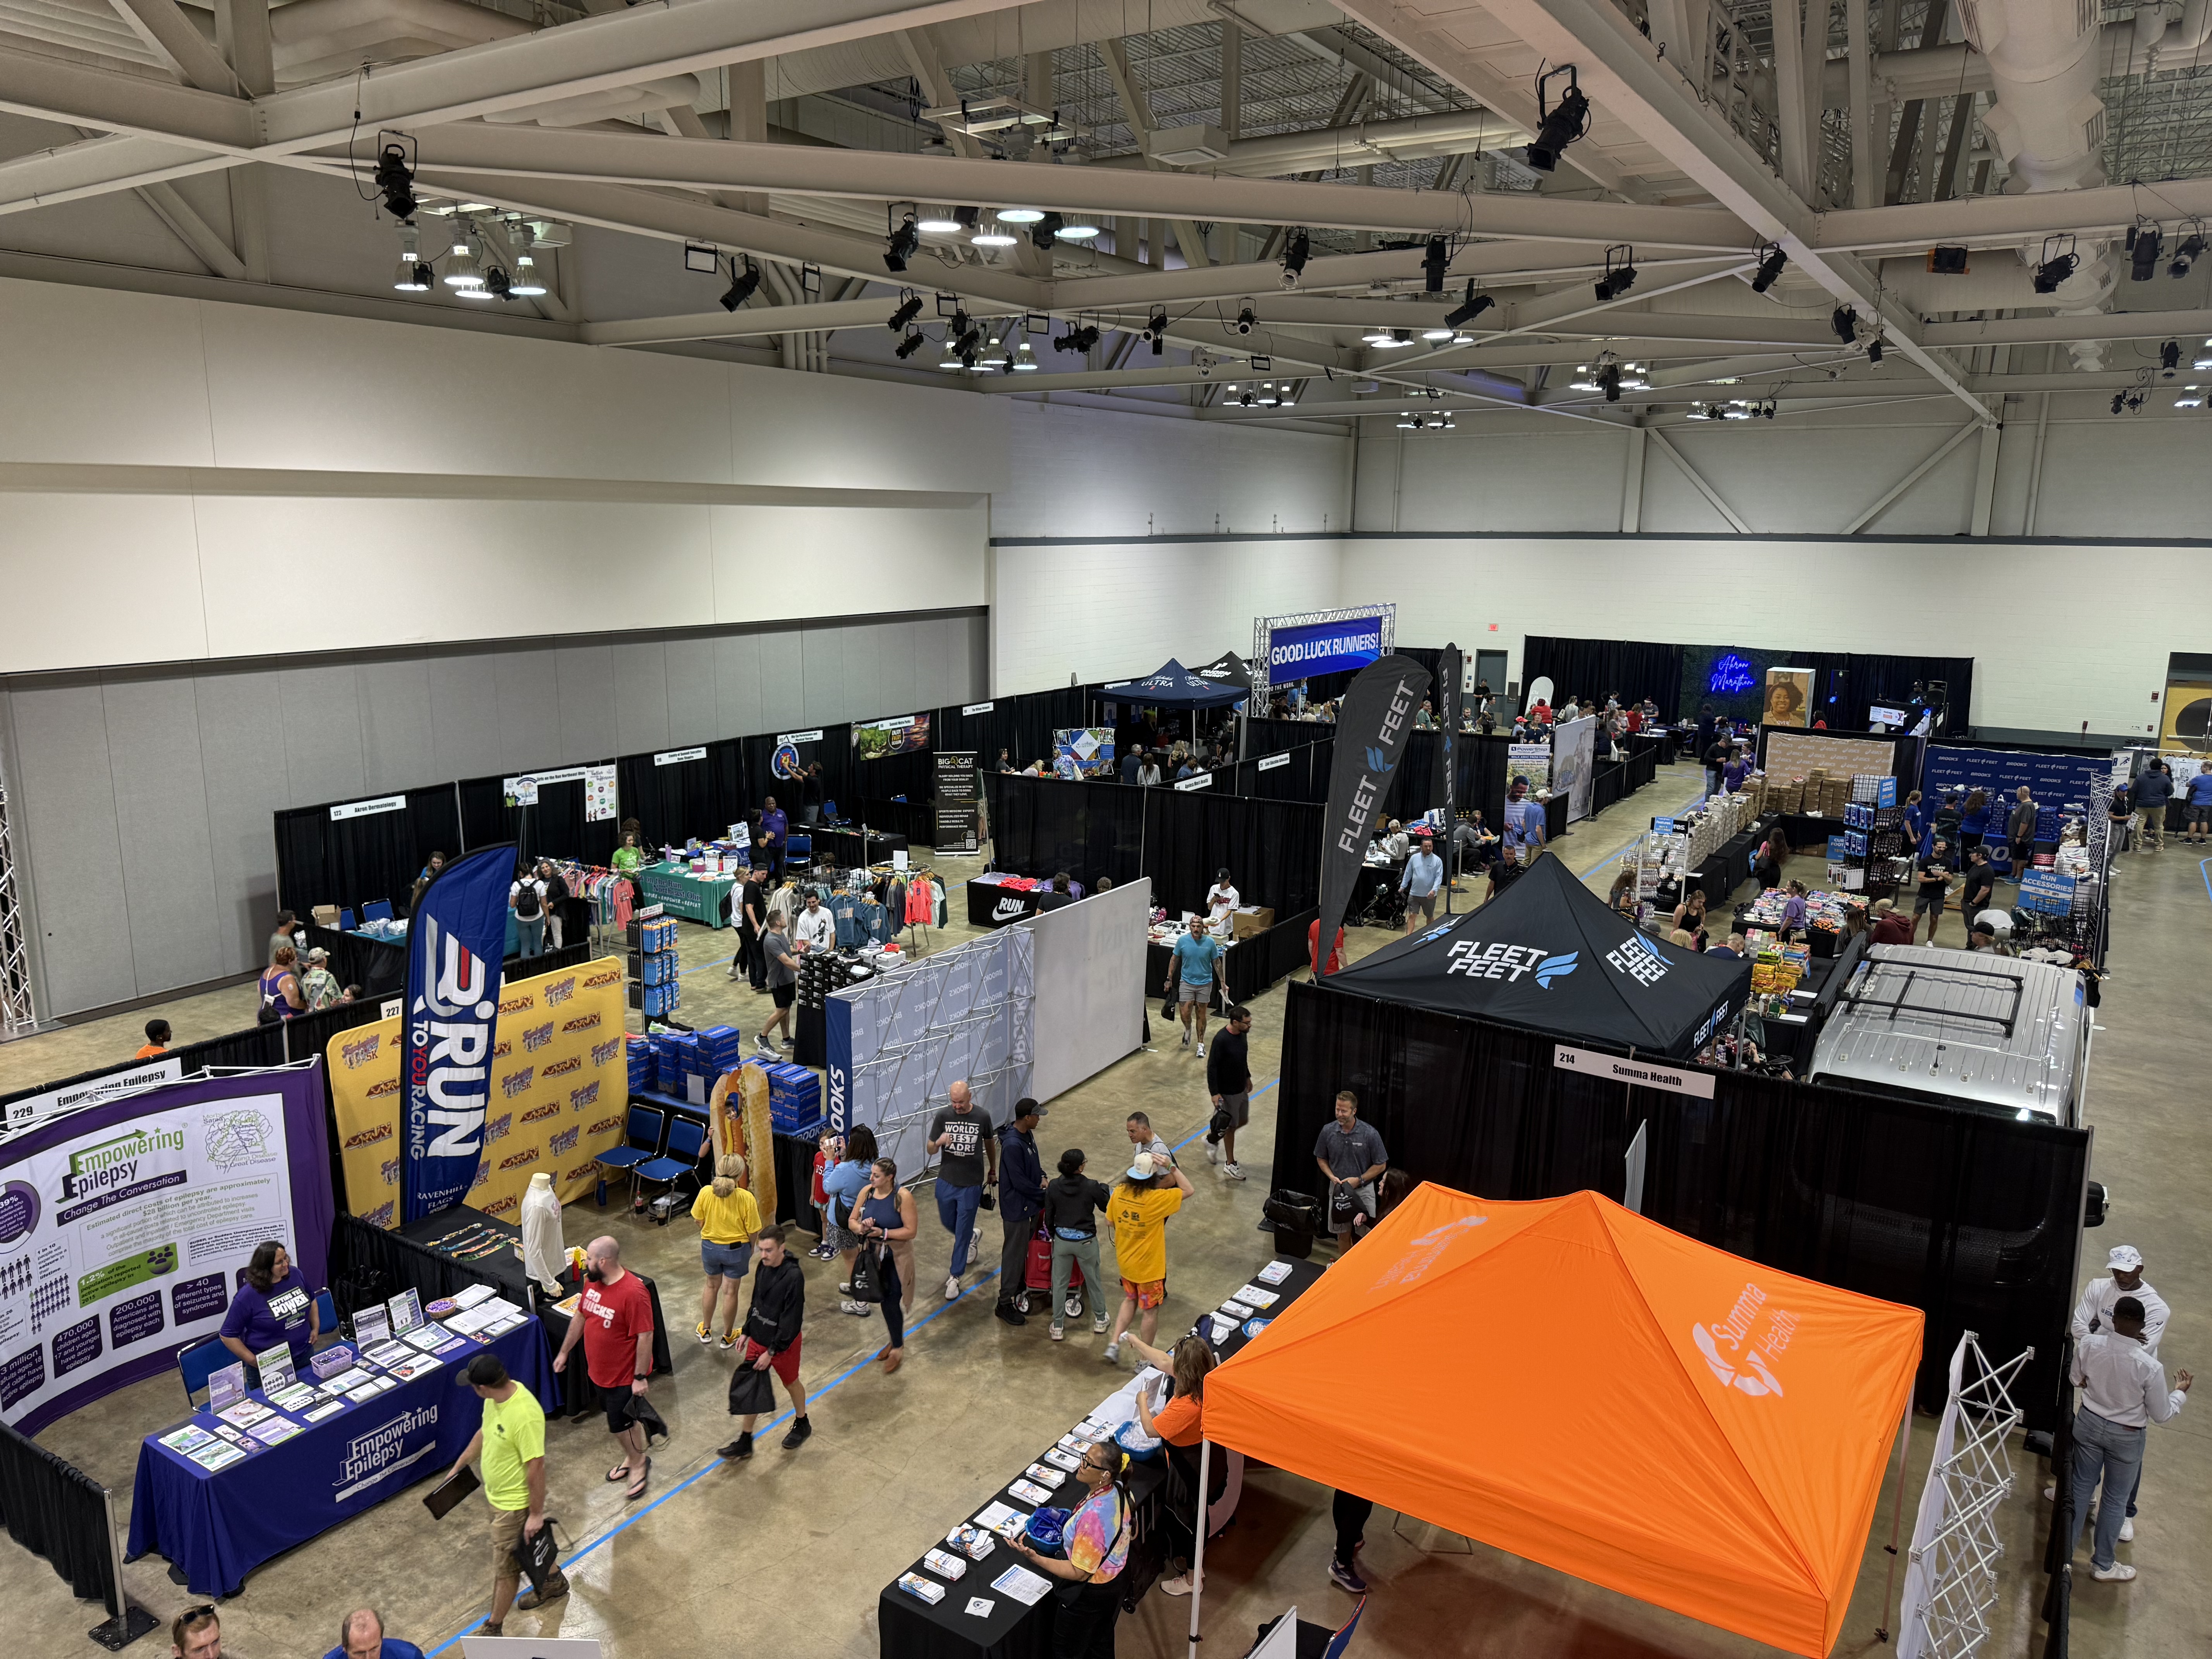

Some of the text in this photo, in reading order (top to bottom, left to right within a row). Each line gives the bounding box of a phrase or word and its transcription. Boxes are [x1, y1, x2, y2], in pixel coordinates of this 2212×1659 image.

[1271, 632, 1379, 665] GOOD LUCK RUNNERS!
[1338, 680, 1413, 853] FLEET FEET
[368, 802, 396, 811] Dermatology
[668, 879, 682, 889] Run
[2022, 878, 2072, 893] ACCESSORIES
[2040, 874, 2056, 882] RUN
[653, 884, 702, 901] Northeast Ohio
[999, 897, 1025, 912] RUN
[1447, 940, 1548, 967] FLEET
[1605, 936, 1650, 974] FLEET
[1446, 958, 1532, 982] FEET
[1629, 955, 1669, 987] FEET
[563, 991, 573, 1001] 5K
[385, 1006, 400, 1018] 227
[1693, 1000, 1729, 1048] FLEET FEET
[609, 1050, 618, 1060] 5K
[1559, 1053, 1682, 1086] 214 Summa Health
[13, 1070, 165, 1119] 229 Empoering Epilepsy
[831, 1064, 844, 1133] OOKS
[797, 1122, 826, 1140] OOKS
[945, 1125, 979, 1134] WORLDS
[949, 1134, 974, 1142] BEST
[69, 1127, 184, 1176] Empowering
[945, 1143, 975, 1152] ADRE
[250, 1157, 276, 1165] Disease
[62, 1160, 137, 1199] Epilepsy
[63, 1175, 180, 1221] Change The Conversation
[417, 1184, 464, 1200] RAVENHILL
[428, 1195, 453, 1209] FLAGS
[79, 1271, 105, 1286] 1.2%
[81, 1265, 141, 1293] population reported
[81, 1286, 99, 1298] active
[100, 1277, 127, 1290] epilepsy
[196, 1278, 209, 1286] 40
[81, 1295, 96, 1304] 2015
[175, 1283, 222, 1300] different types
[182, 1295, 210, 1306] seizures
[211, 1290, 225, 1298] and
[586, 1288, 601, 1303] GO
[115, 1294, 155, 1315] 200,000
[182, 1300, 218, 1314] syndromes
[271, 1293, 309, 1317] POWER
[582, 1298, 615, 1320] BUCKS
[113, 1306, 147, 1324] Americans
[113, 1309, 161, 1331] diagnosed with
[1711, 1283, 1767, 1351] Summa
[57, 1319, 94, 1342] 470,000
[115, 1317, 160, 1338] epilepsy each
[131, 1330, 146, 1341] year
[1755, 1309, 1796, 1362] Health
[57, 1328, 96, 1351] children ages
[63, 1346, 75, 1356] and
[76, 1334, 100, 1350] younger
[61, 1345, 94, 1365] have active
[66, 1354, 91, 1370] epilepsy
[347, 1404, 438, 1460] Empowering
[340, 1438, 404, 1480] Epilepsy
